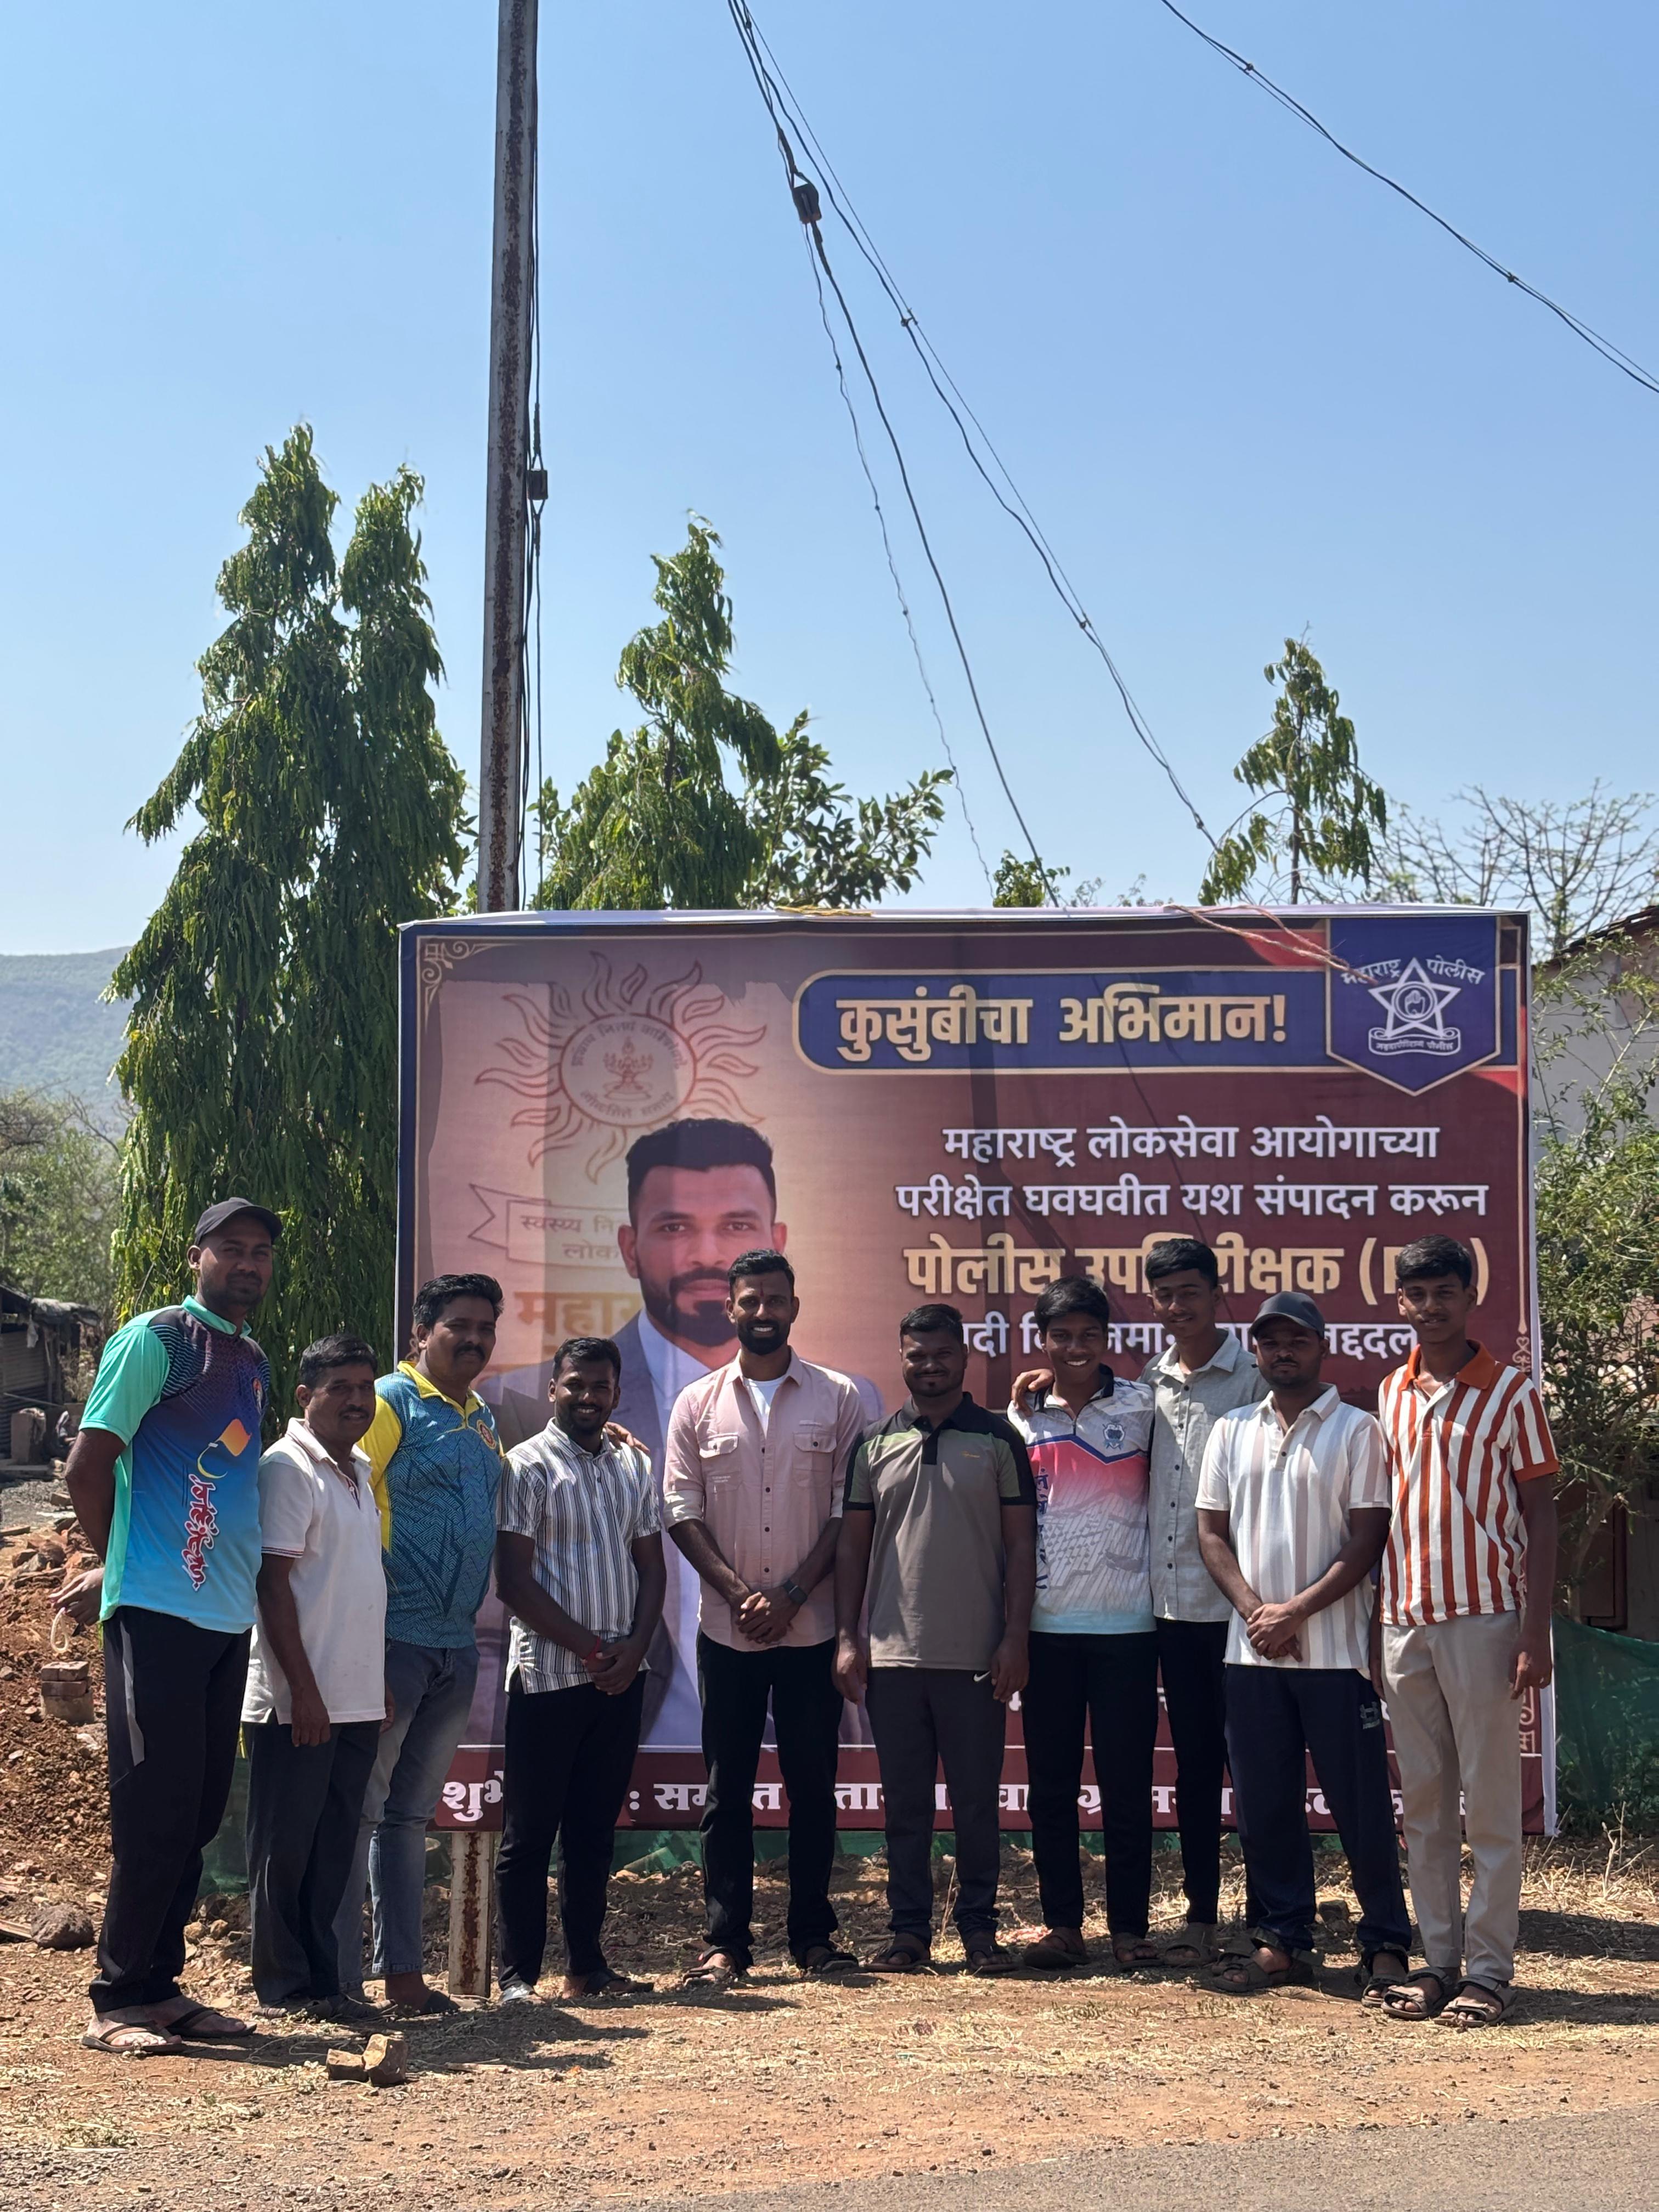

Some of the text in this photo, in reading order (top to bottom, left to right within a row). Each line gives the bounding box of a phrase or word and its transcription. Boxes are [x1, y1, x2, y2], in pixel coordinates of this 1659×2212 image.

[1425, 955, 1485, 985] पोलीस
[836, 982, 1286, 1062] कुसुंबीचा अभिमान!
[943, 1115, 1441, 1167] महाराष्ट्र लोकसेवा आयोगाच्या
[895, 1172, 1489, 1220] परीक्षेत घवघवीत यश संपादन करून
[903, 1232, 1066, 1294] पोलीस
